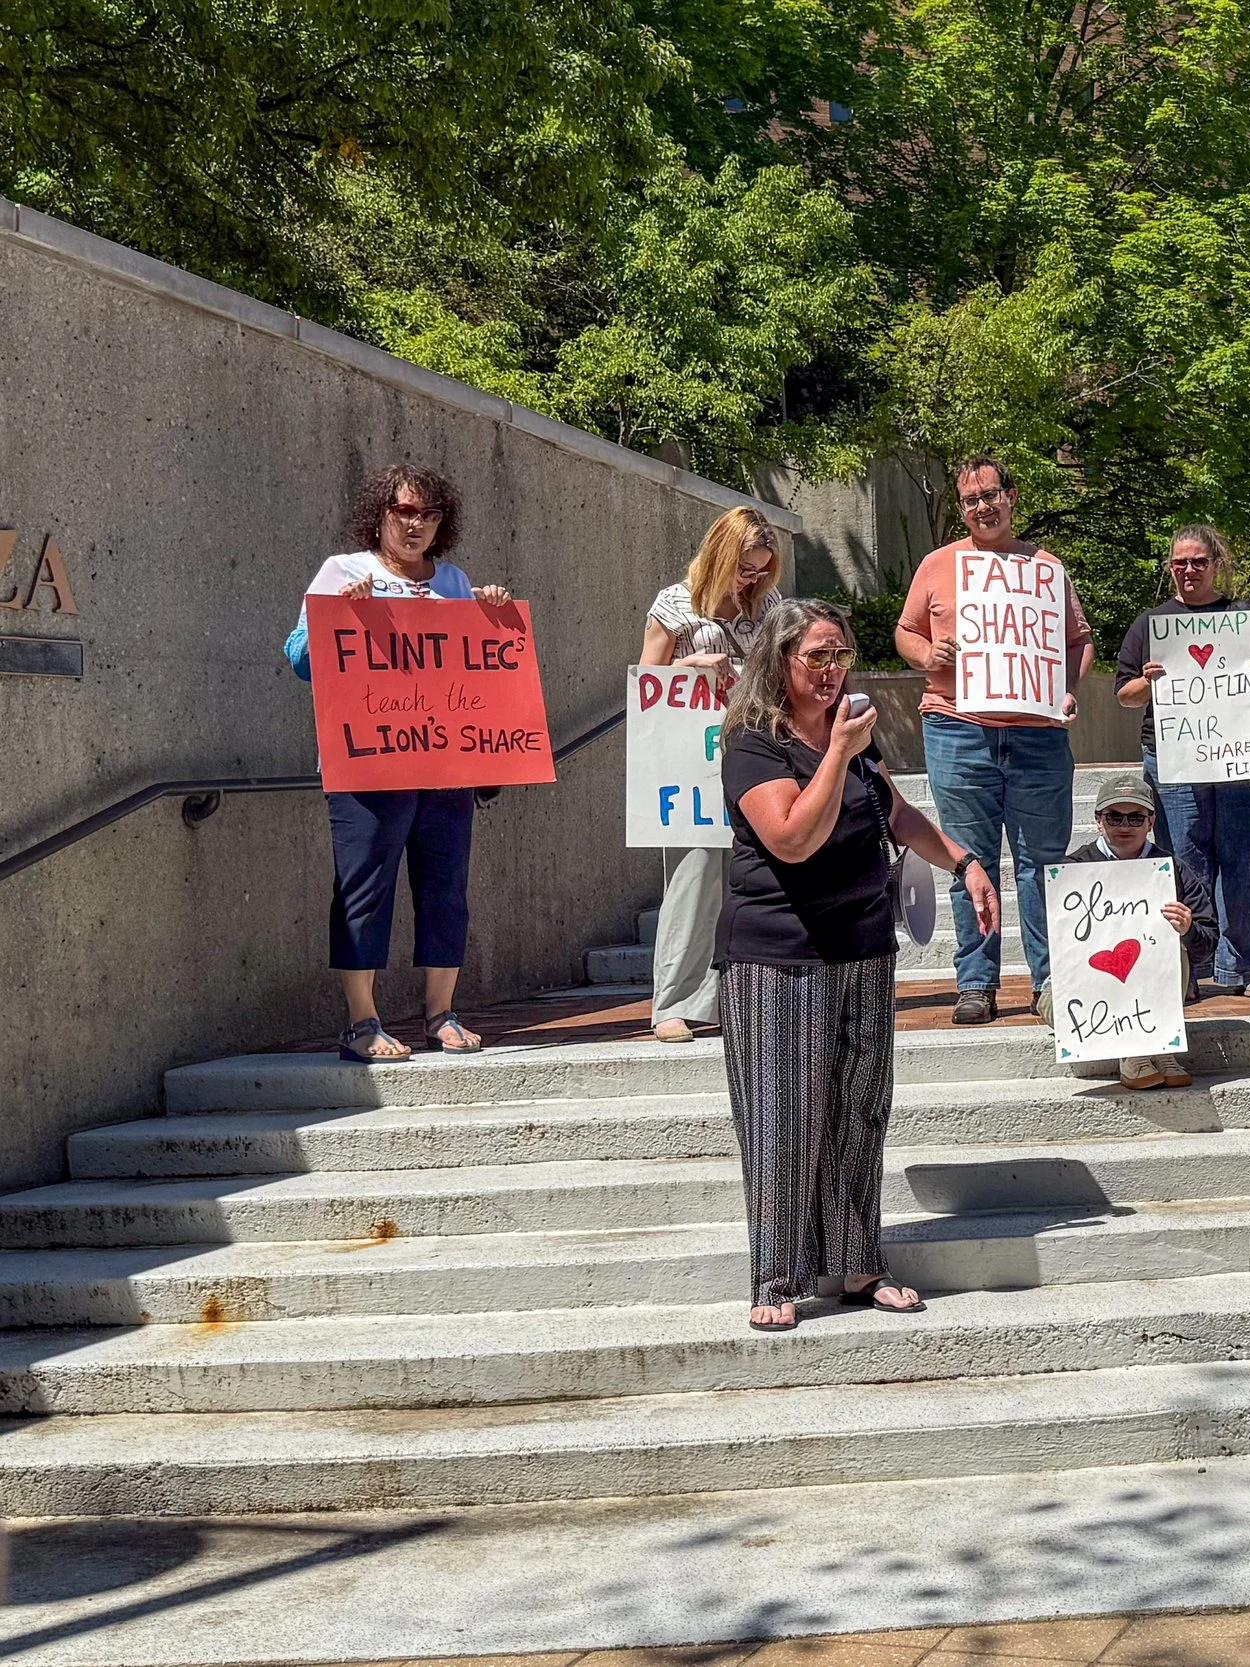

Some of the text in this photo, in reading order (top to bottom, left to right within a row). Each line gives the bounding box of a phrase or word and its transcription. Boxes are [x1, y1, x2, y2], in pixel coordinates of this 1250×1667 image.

[961, 556, 1056, 602] FAIR
[960, 603, 1060, 653] SHARE
[1152, 612, 1248, 640] UMMAP
[333, 629, 449, 673] FLINT
[363, 682, 486, 715] teach the
[961, 651, 1062, 706] FLINT
[343, 716, 545, 758] LION'S SHARE
[1160, 715, 1223, 741] FAIR
[1063, 880, 1149, 942] glam
[1067, 998, 1156, 1043] flint
